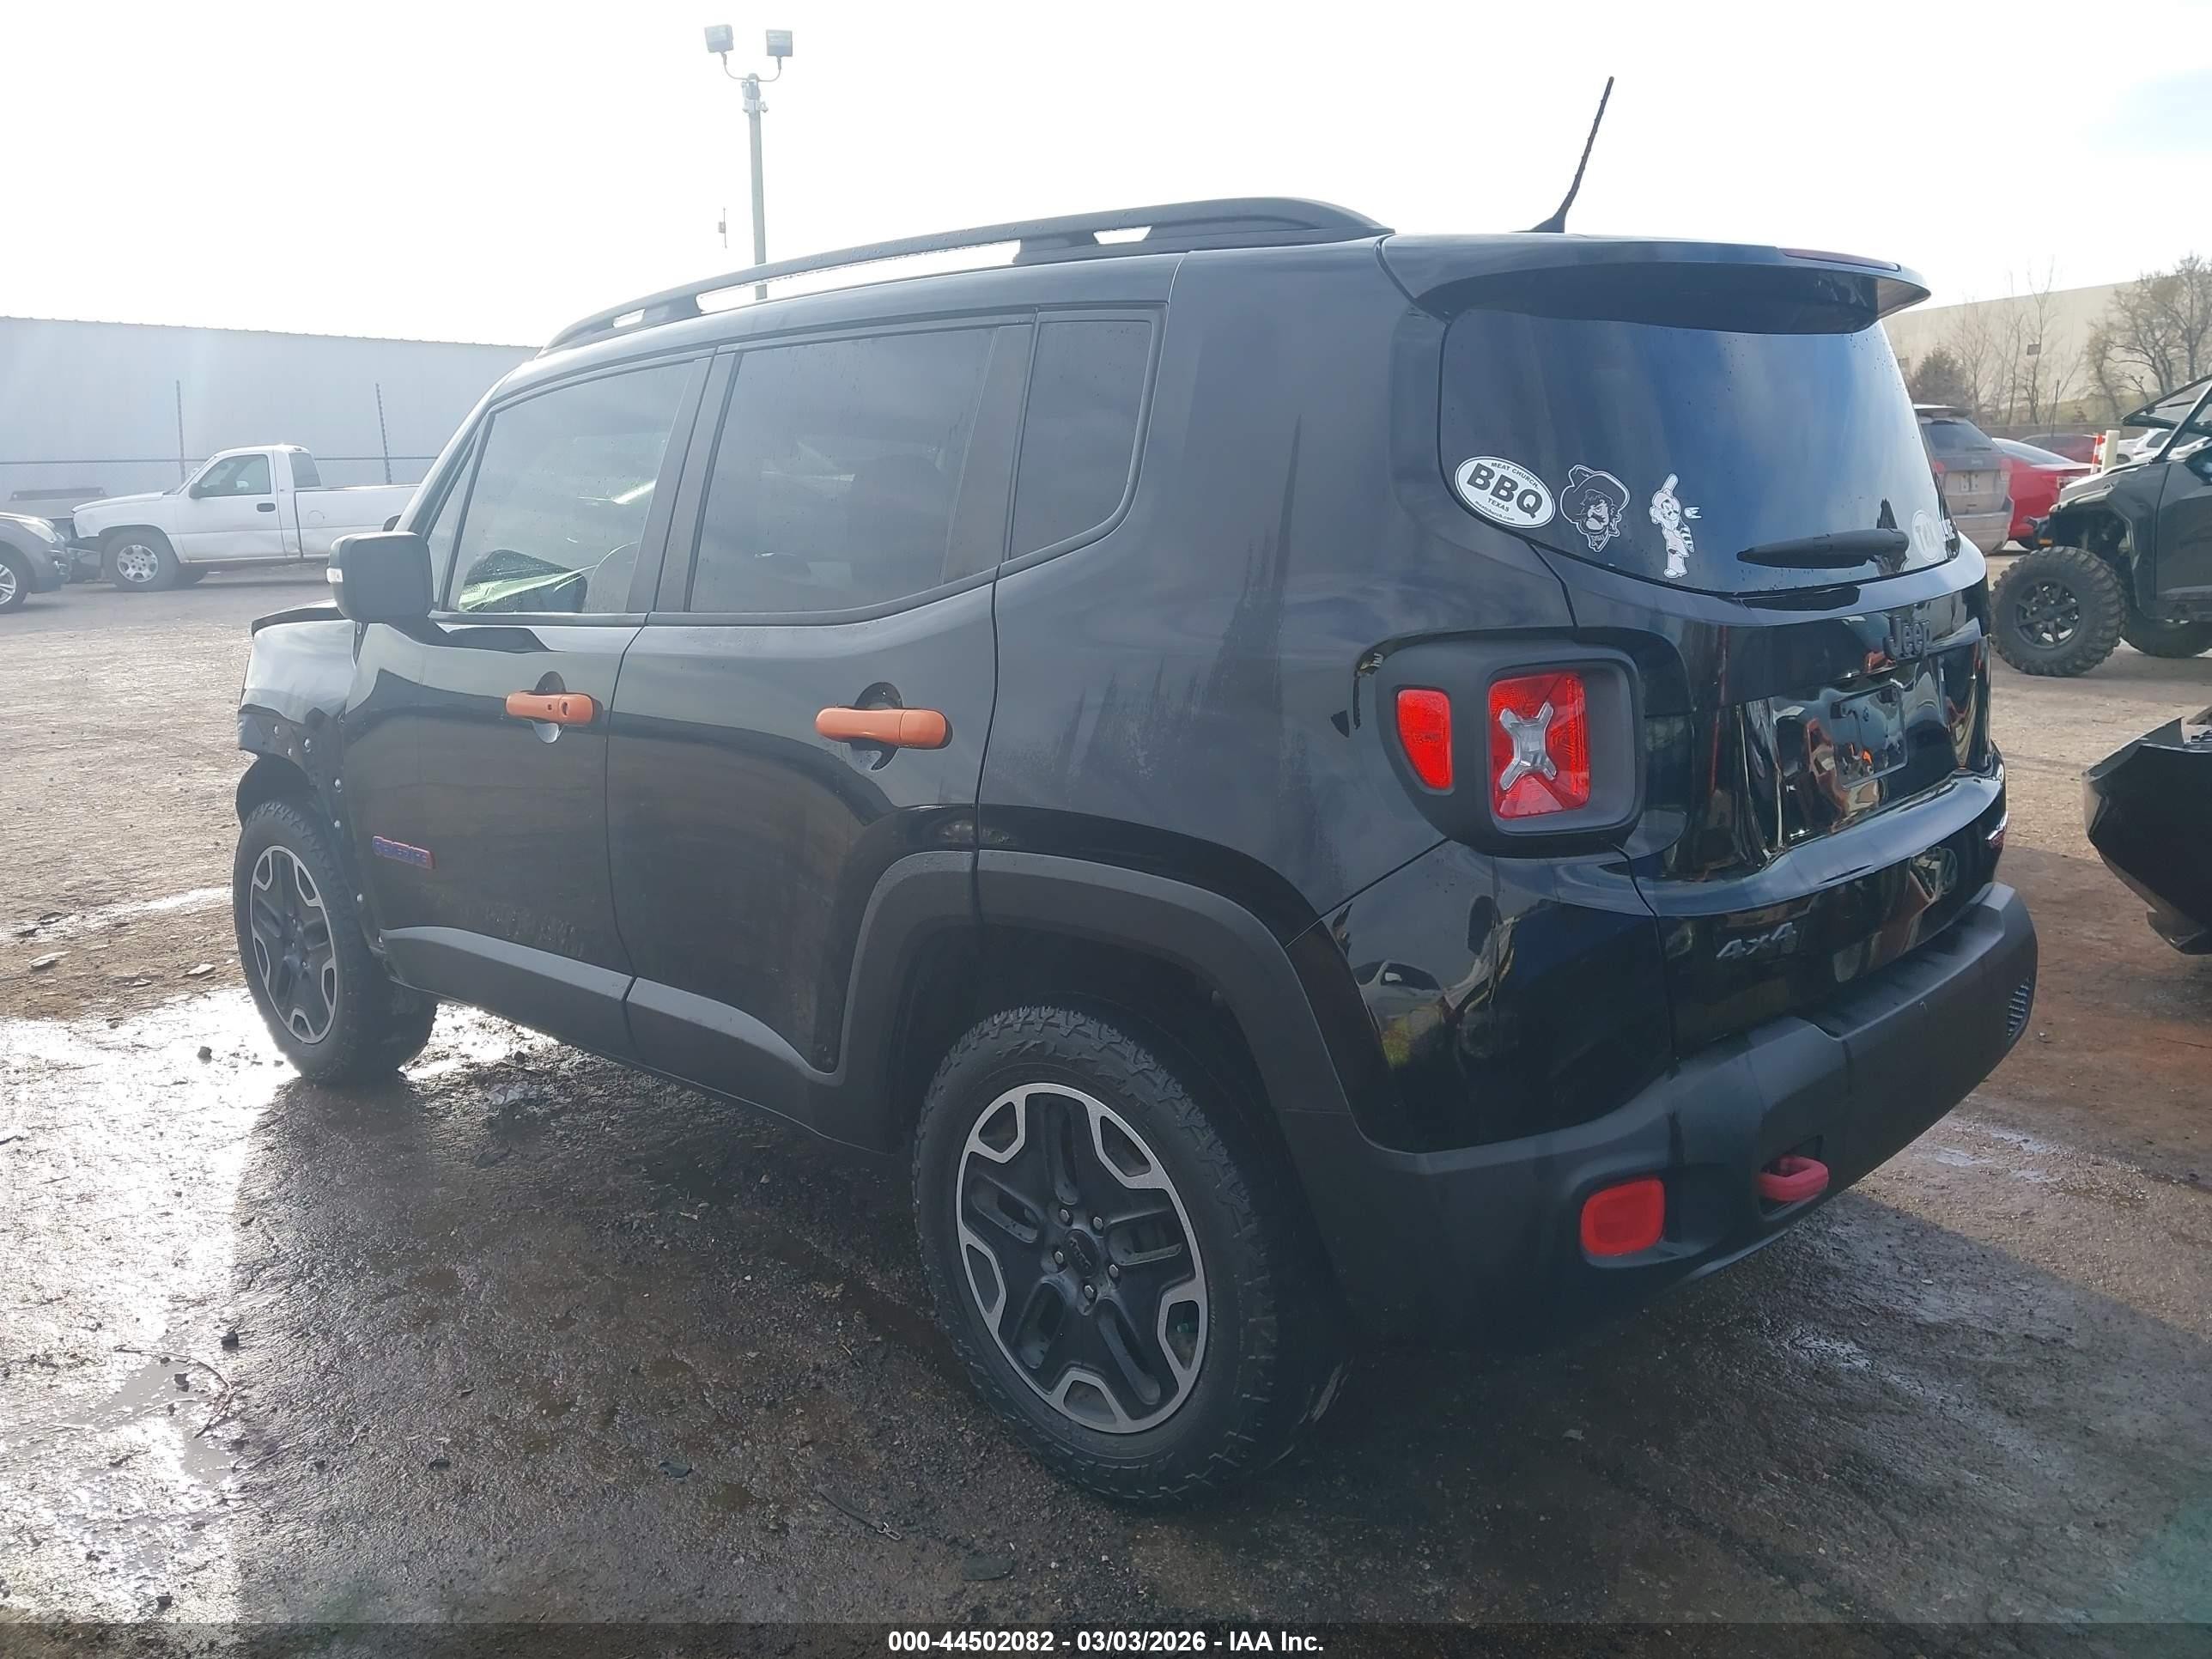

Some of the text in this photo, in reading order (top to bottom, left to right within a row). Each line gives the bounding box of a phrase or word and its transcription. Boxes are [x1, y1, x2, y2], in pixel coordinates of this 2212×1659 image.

[1491, 462, 1511, 471] MEAT
[1467, 462, 1543, 519] BBQ
[1487, 497, 1510, 513] TEXAS
[1886, 615, 1932, 659] Jeep
[1716, 921, 1797, 959] 4x4
